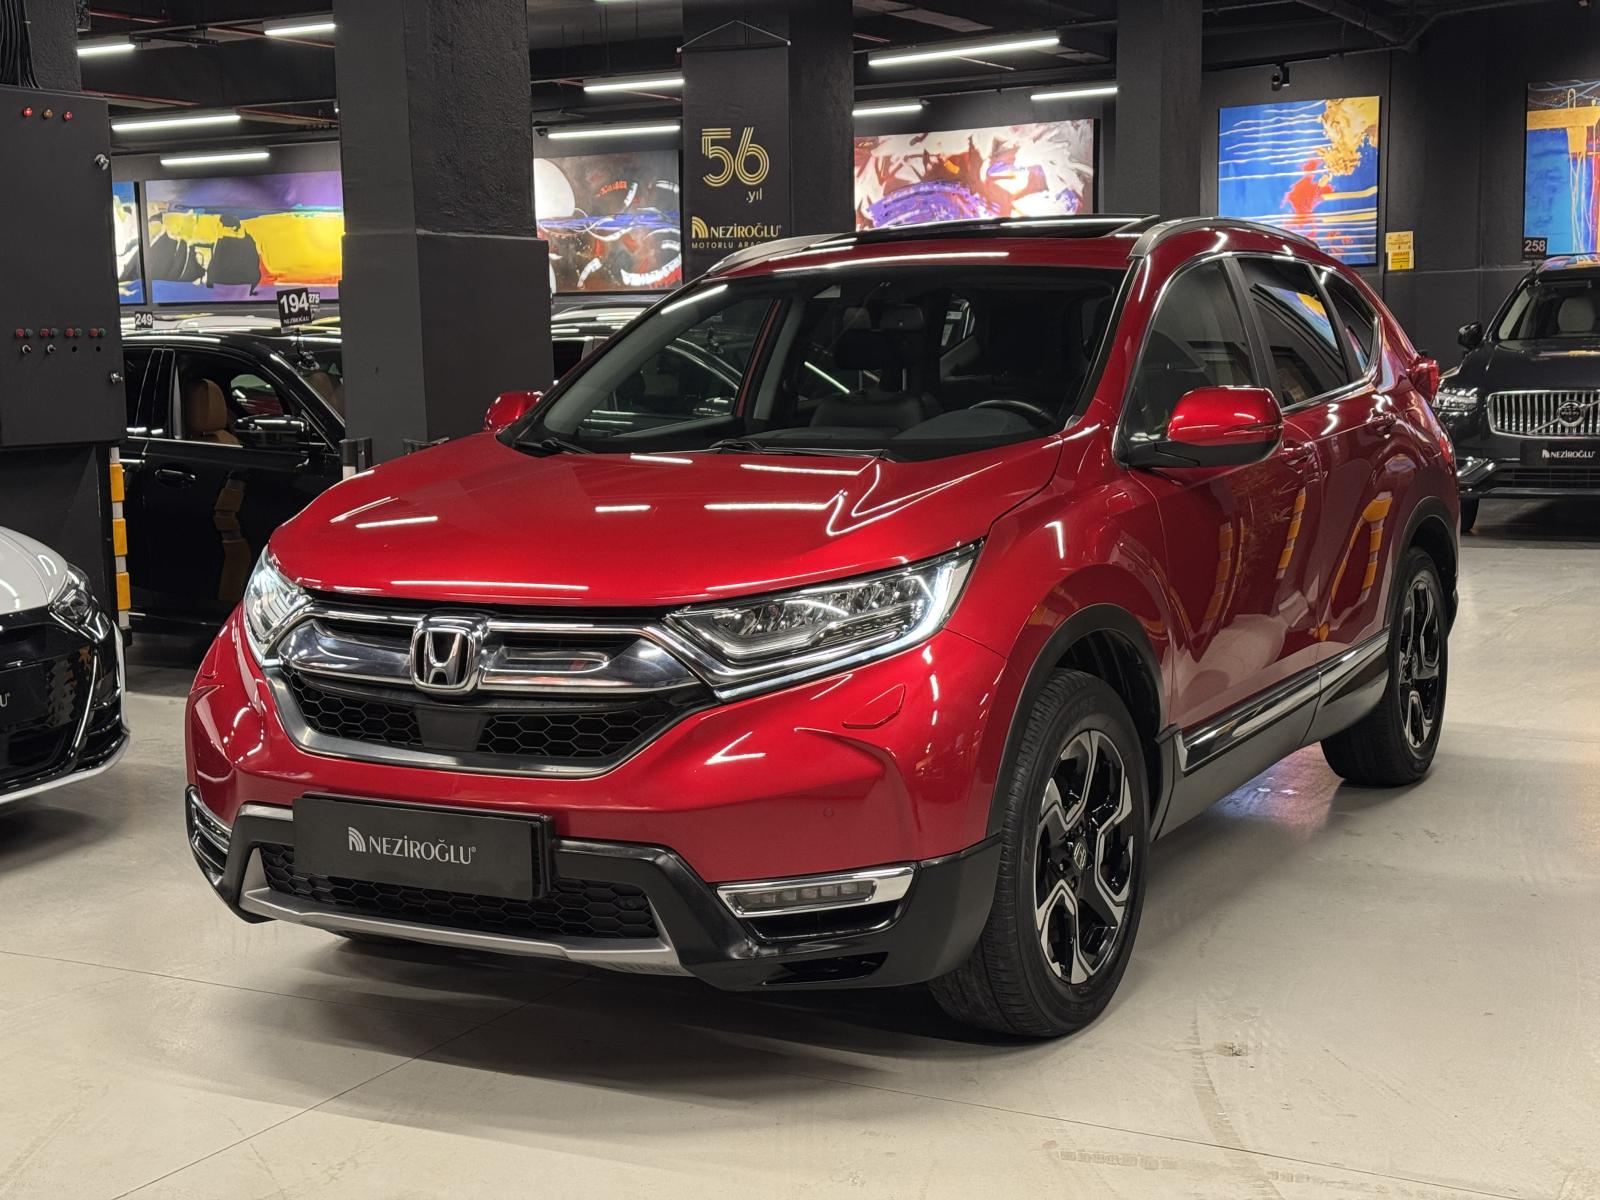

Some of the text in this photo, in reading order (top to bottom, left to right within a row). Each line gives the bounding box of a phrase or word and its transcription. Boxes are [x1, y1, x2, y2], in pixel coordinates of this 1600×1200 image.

[701, 127, 770, 187] 56
[1524, 239, 1546, 252] 258
[280, 291, 309, 314] 194
[135, 313, 153, 326] 249
[369, 835, 472, 865] NEZİROĞLU
